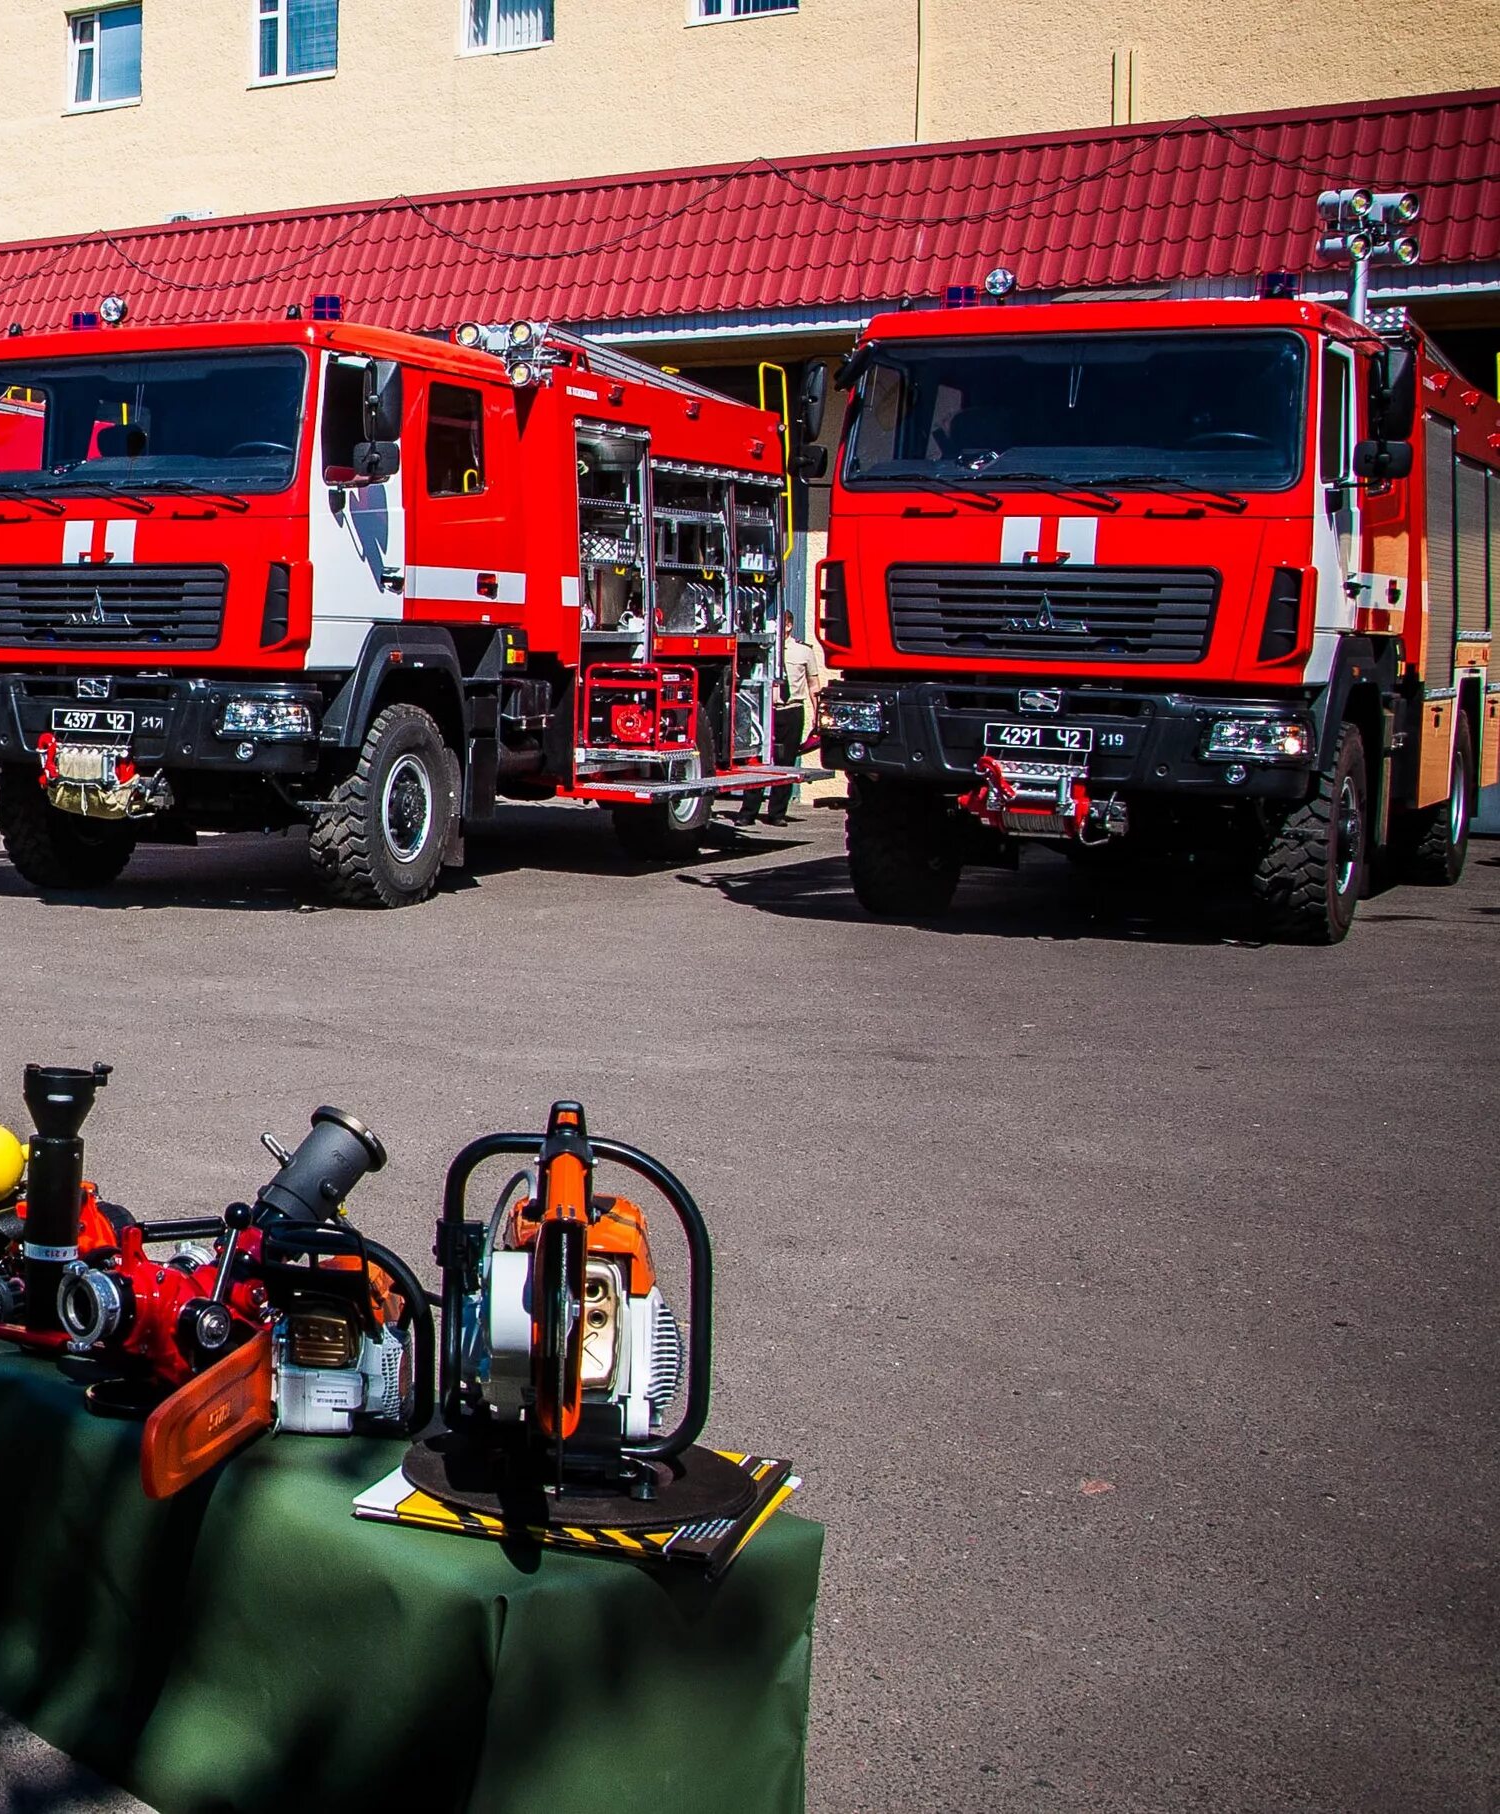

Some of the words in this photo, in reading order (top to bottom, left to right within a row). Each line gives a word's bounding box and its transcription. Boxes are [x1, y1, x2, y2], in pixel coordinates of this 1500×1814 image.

[63, 712, 97, 729] 4397
[1000, 727, 1041, 746] 4291
[1100, 734, 1124, 746] 219
